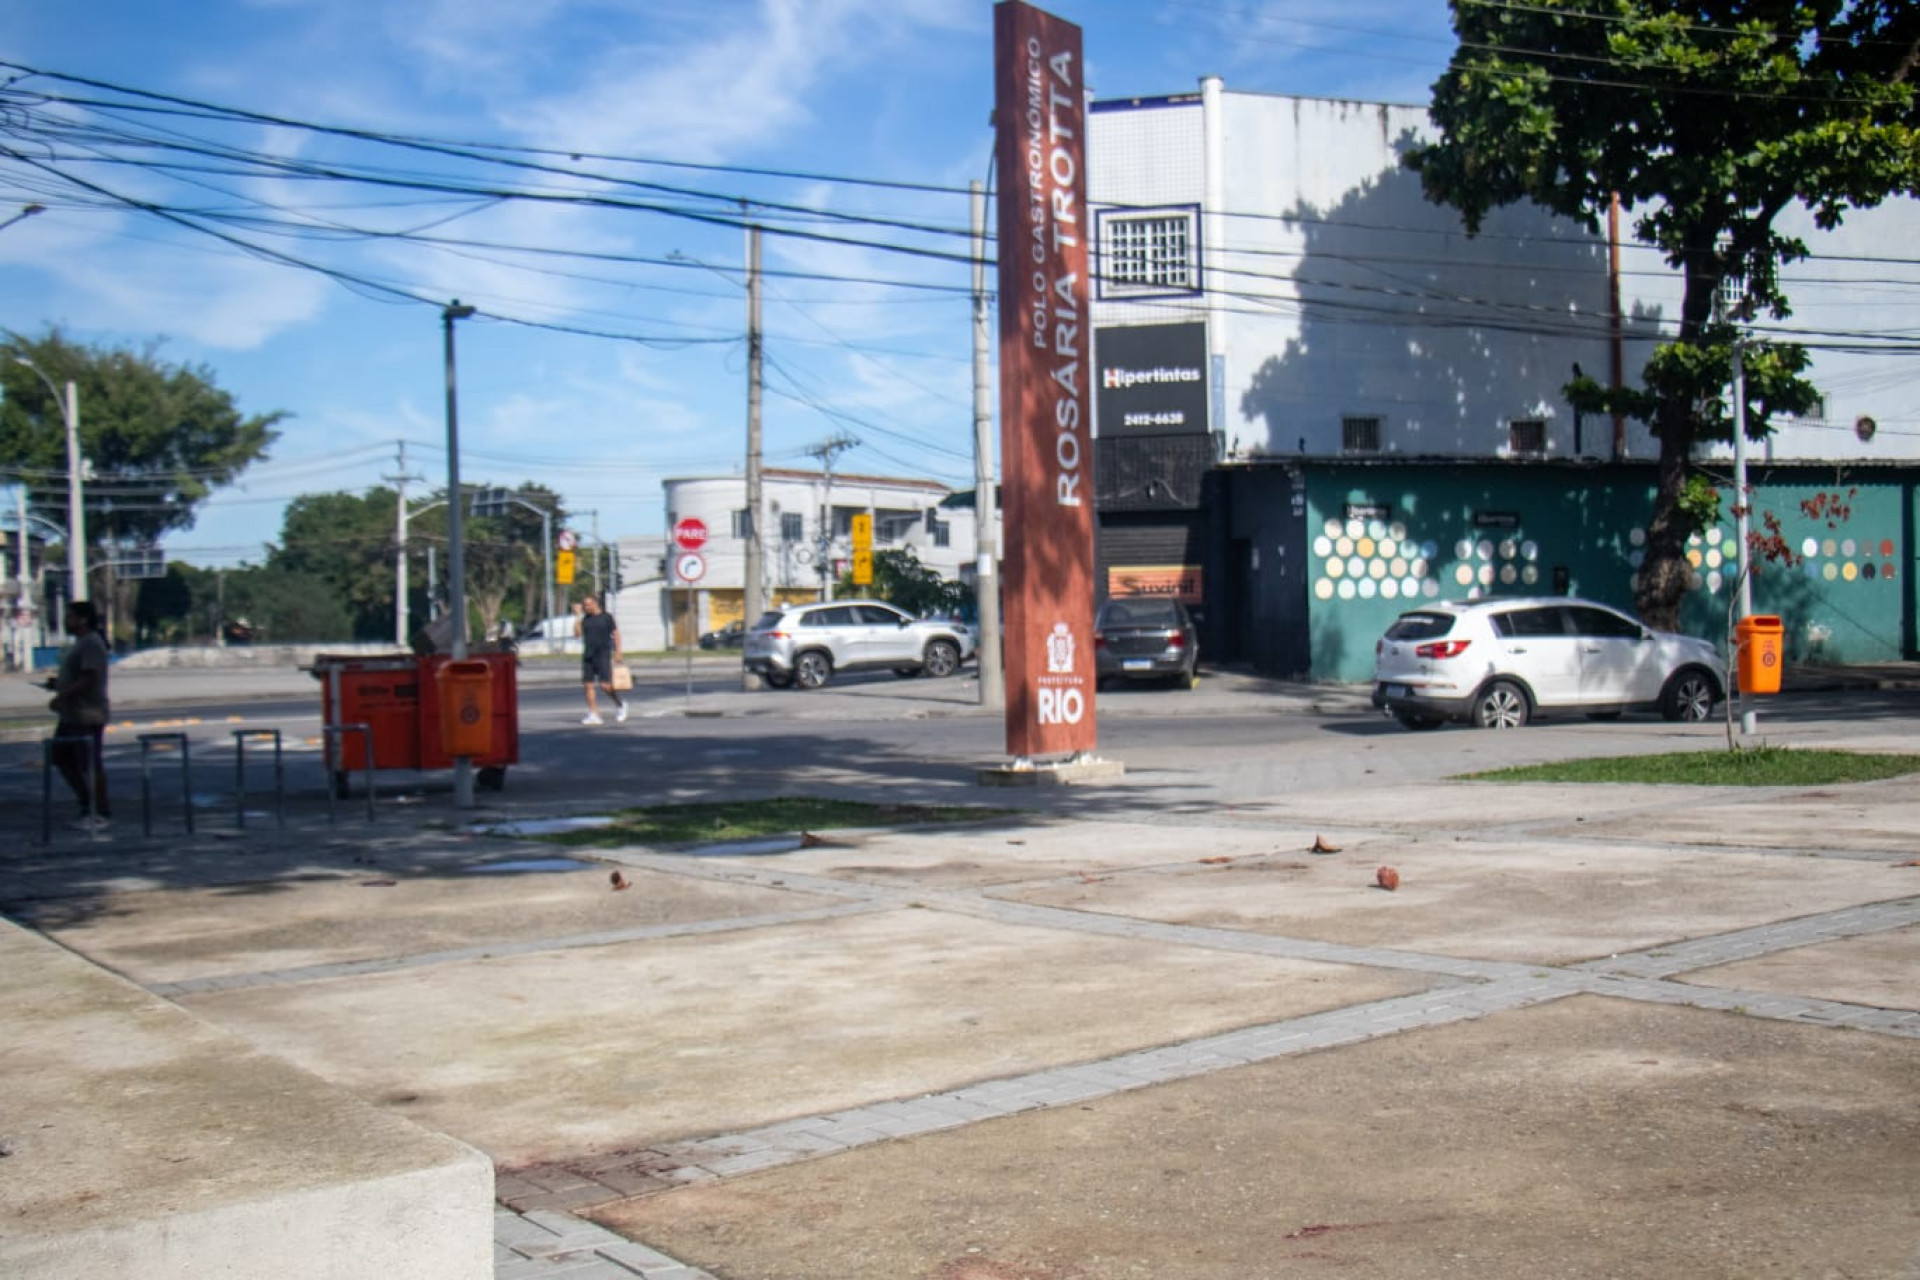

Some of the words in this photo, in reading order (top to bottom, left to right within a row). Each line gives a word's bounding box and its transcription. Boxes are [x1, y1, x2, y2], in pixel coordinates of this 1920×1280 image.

[1050, 51, 1077, 253] TROTTA
[1033, 273, 1047, 348] POLO
[1051, 272, 1081, 507] ROSÁRIA
[1103, 368, 1200, 388] Hipertintas
[675, 528, 706, 538] PARE
[1038, 688, 1083, 724] RIO
